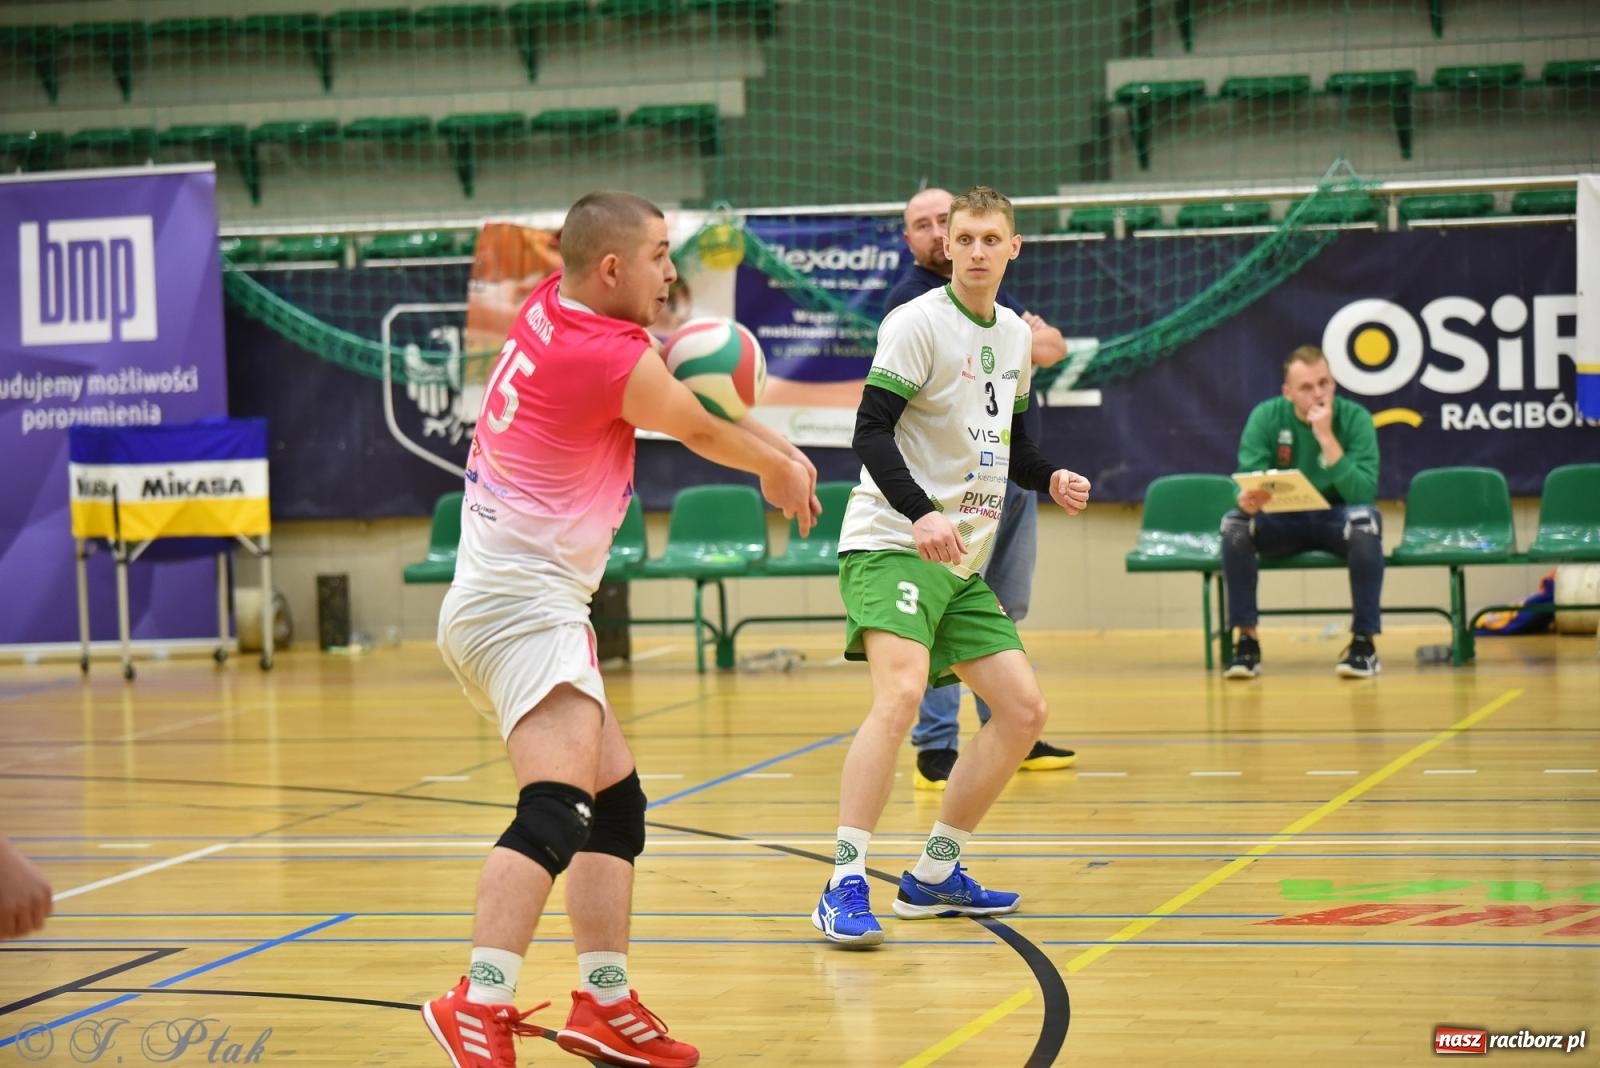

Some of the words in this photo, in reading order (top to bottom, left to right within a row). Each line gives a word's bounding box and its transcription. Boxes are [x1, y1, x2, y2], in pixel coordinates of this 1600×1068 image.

[757, 243, 899, 273] lexadin
[36, 216, 140, 343] bmp
[87, 365, 198, 395] możliwości
[481, 338, 537, 433] 15
[984, 381, 999, 417] 3
[895, 580, 920, 615] 3
